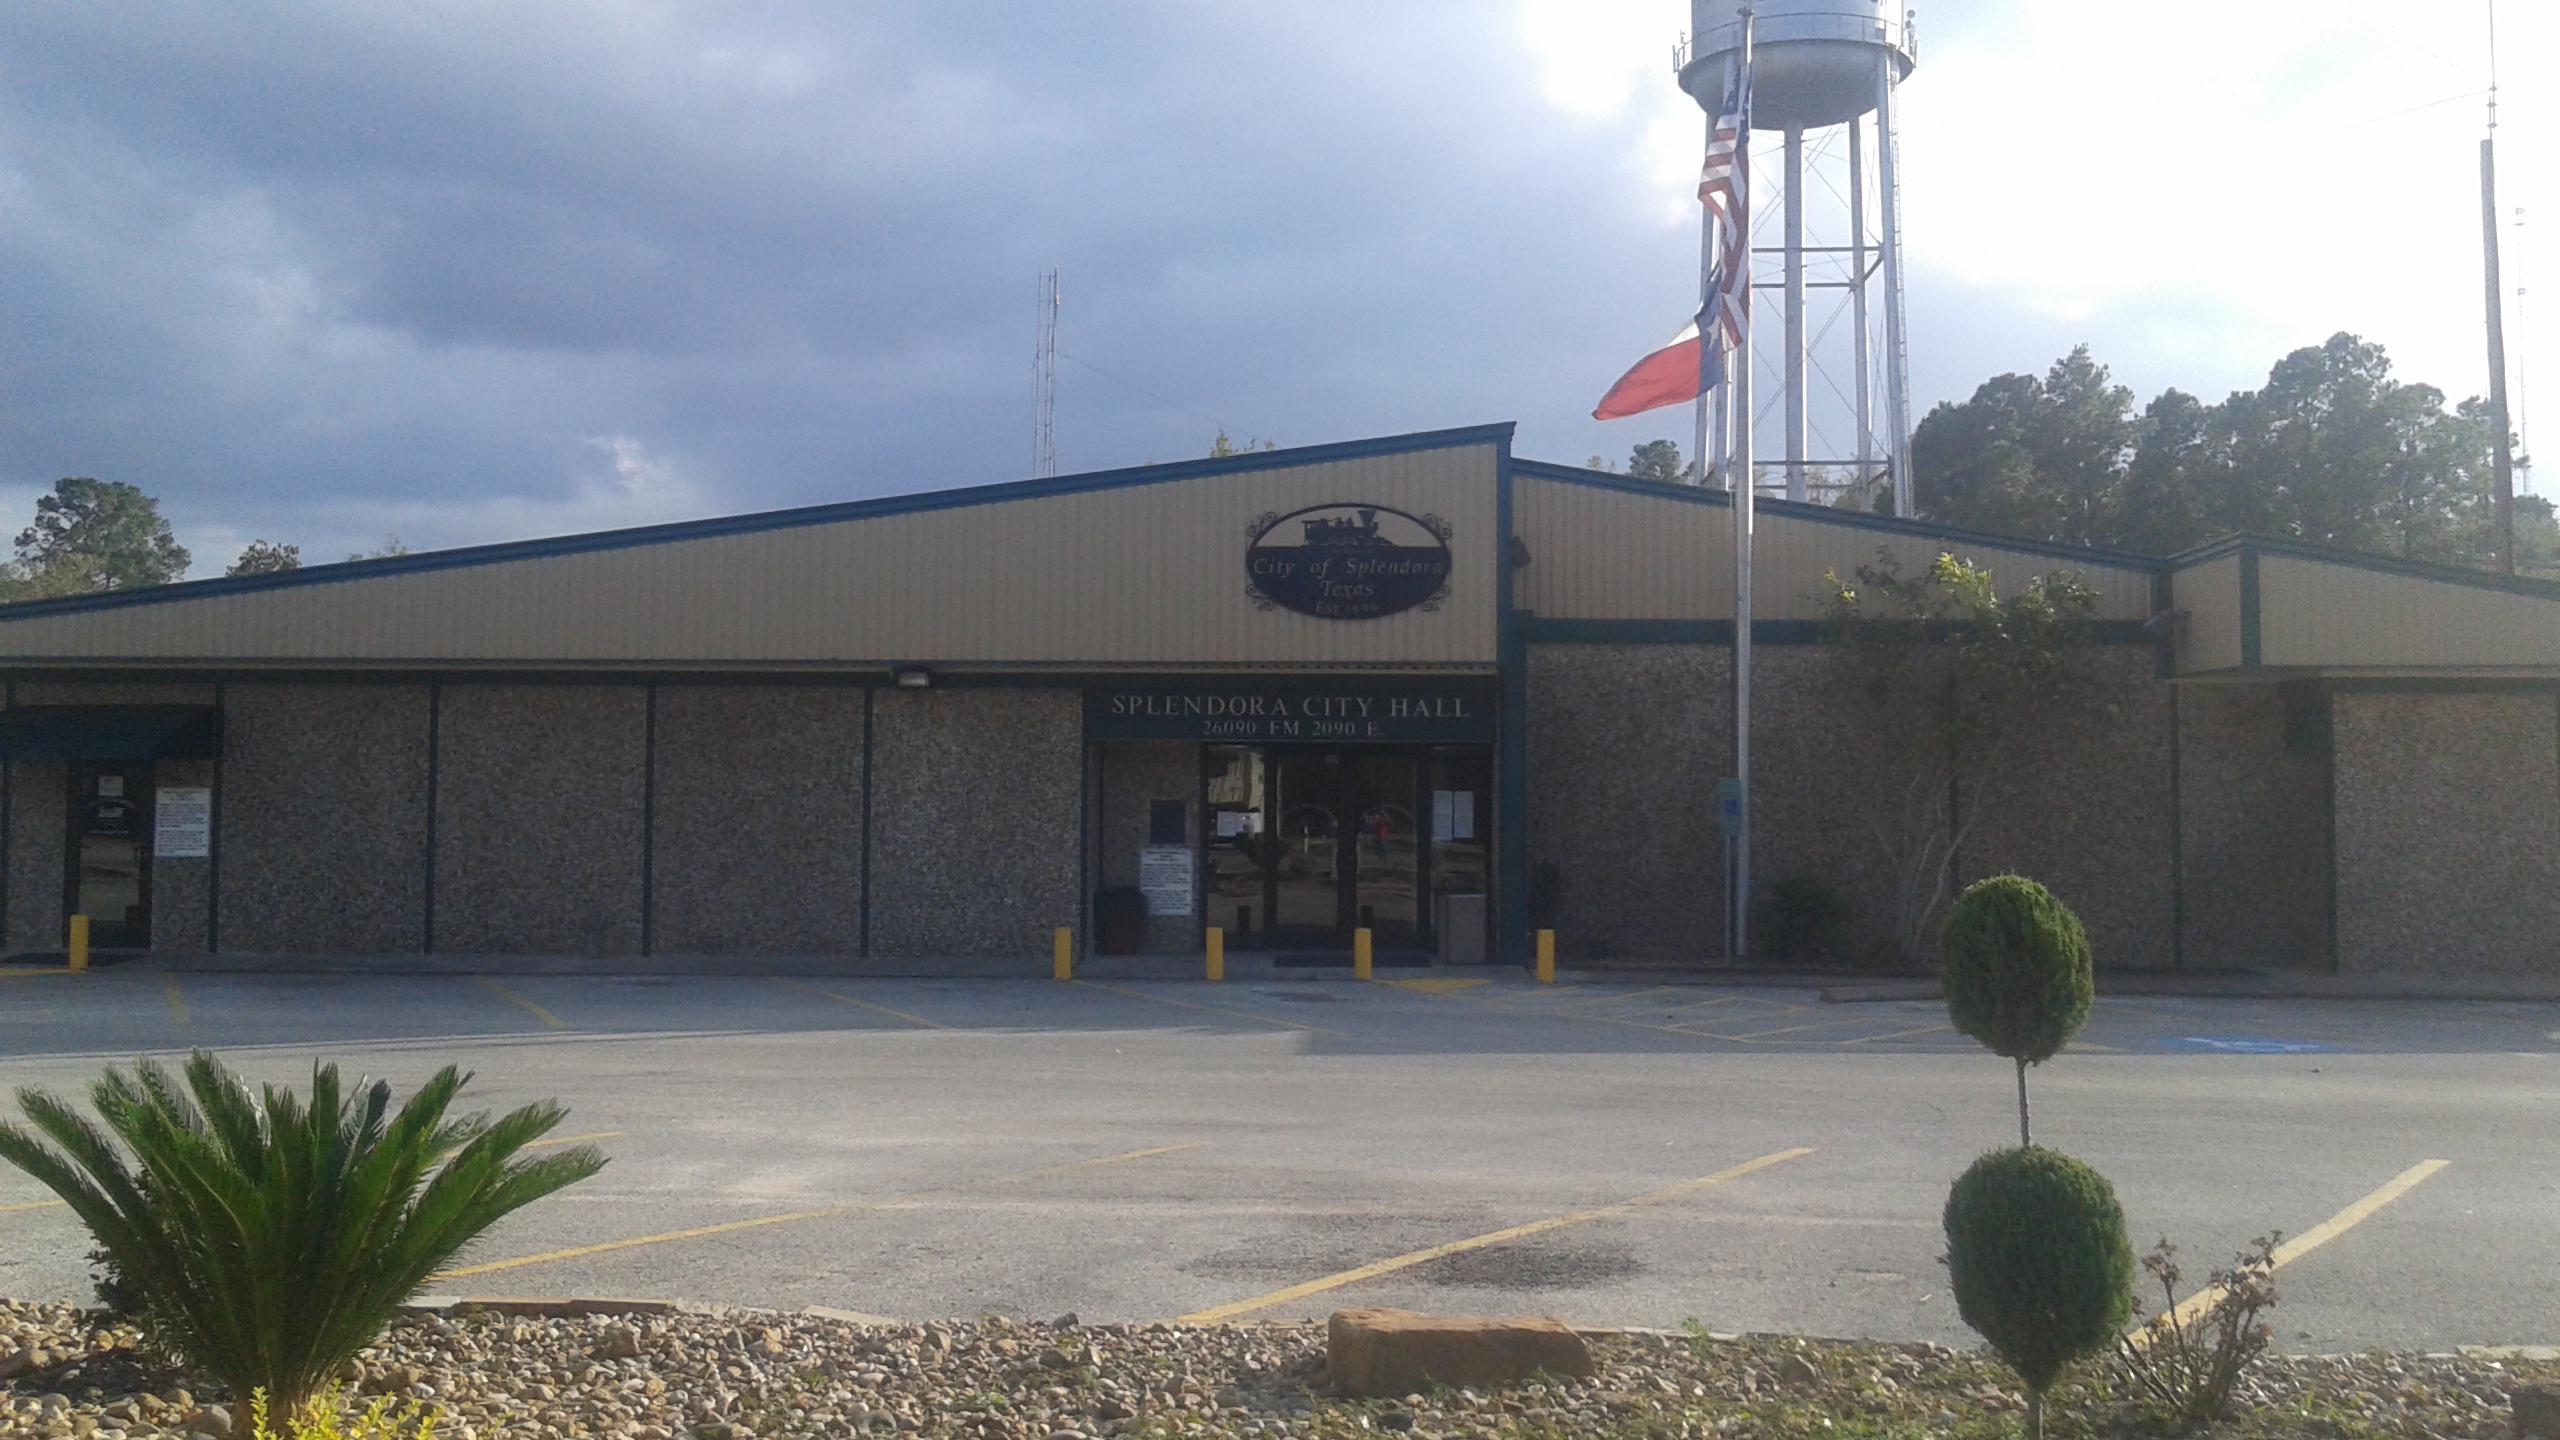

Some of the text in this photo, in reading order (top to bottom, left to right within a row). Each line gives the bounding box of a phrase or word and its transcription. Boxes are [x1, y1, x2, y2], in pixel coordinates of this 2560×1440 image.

[1254, 558, 1443, 579] City of Splendora
[1320, 580, 1374, 599] Texas
[1112, 695, 1471, 718] SPLENDORA CITY HALL
[1202, 720, 1256, 735] 26090
[1270, 720, 1299, 735] FM
[1312, 720, 1355, 736] 2090
